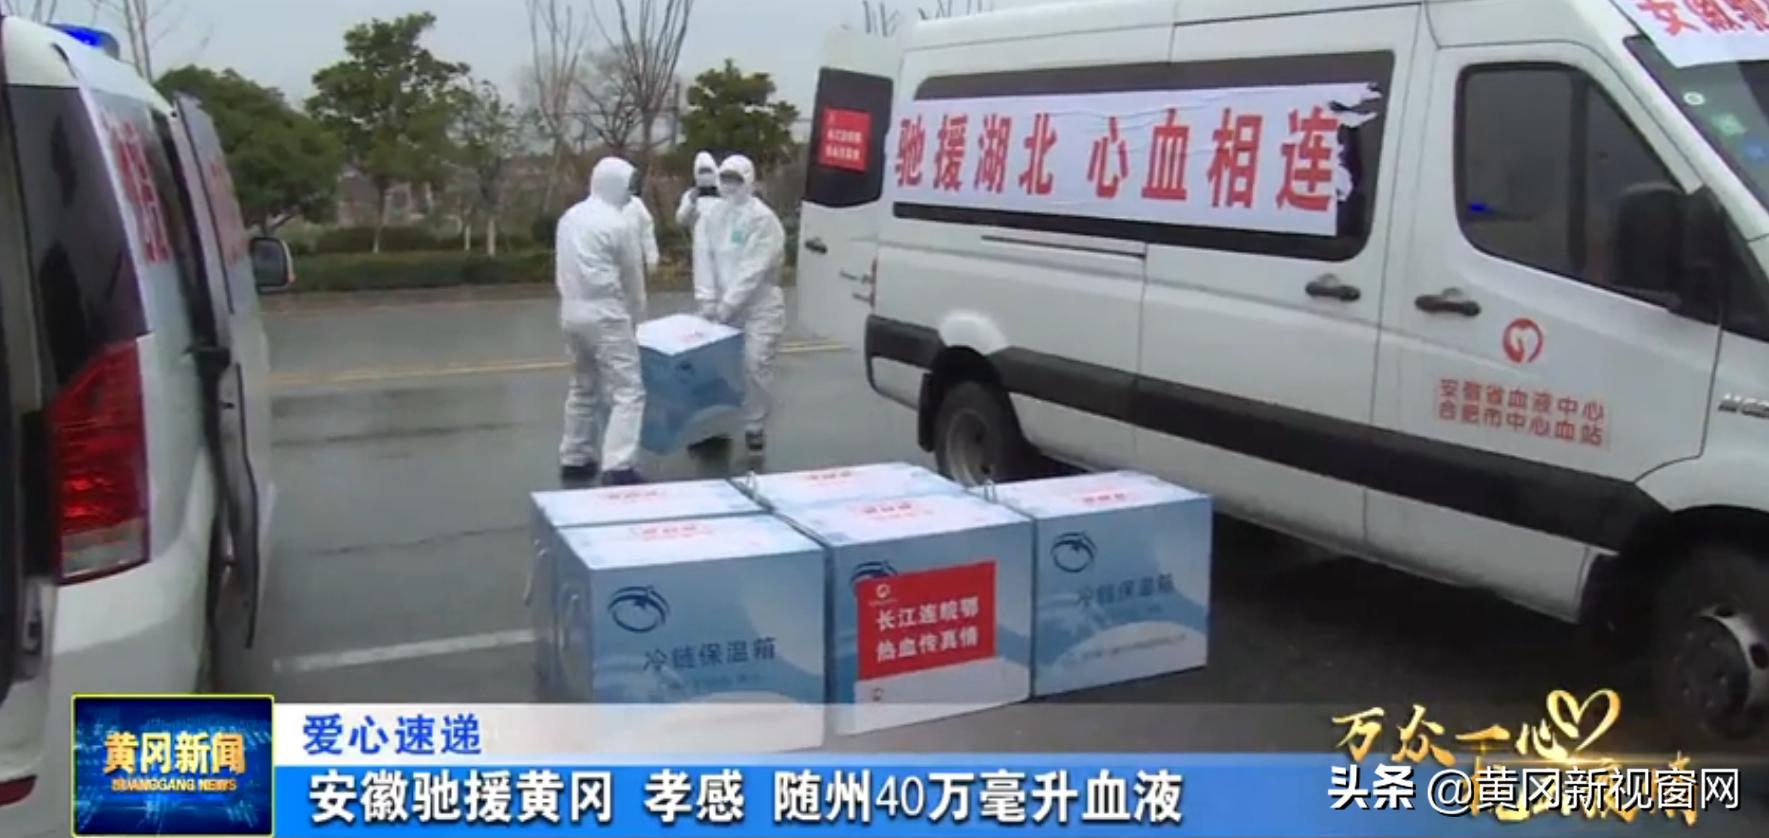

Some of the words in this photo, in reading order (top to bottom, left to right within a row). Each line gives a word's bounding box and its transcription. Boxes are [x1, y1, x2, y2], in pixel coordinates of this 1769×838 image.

[895, 112, 1058, 194] 驰援湖北
[1087, 107, 1339, 211] 心血相连
[1439, 378, 1605, 422] 安徽省血液中心
[1438, 400, 1604, 447] 合肥市中心血站
[876, 595, 979, 632] 长江连皖鄂
[642, 636, 777, 673] 冷链保温箱
[876, 626, 979, 663] 热血传真情
